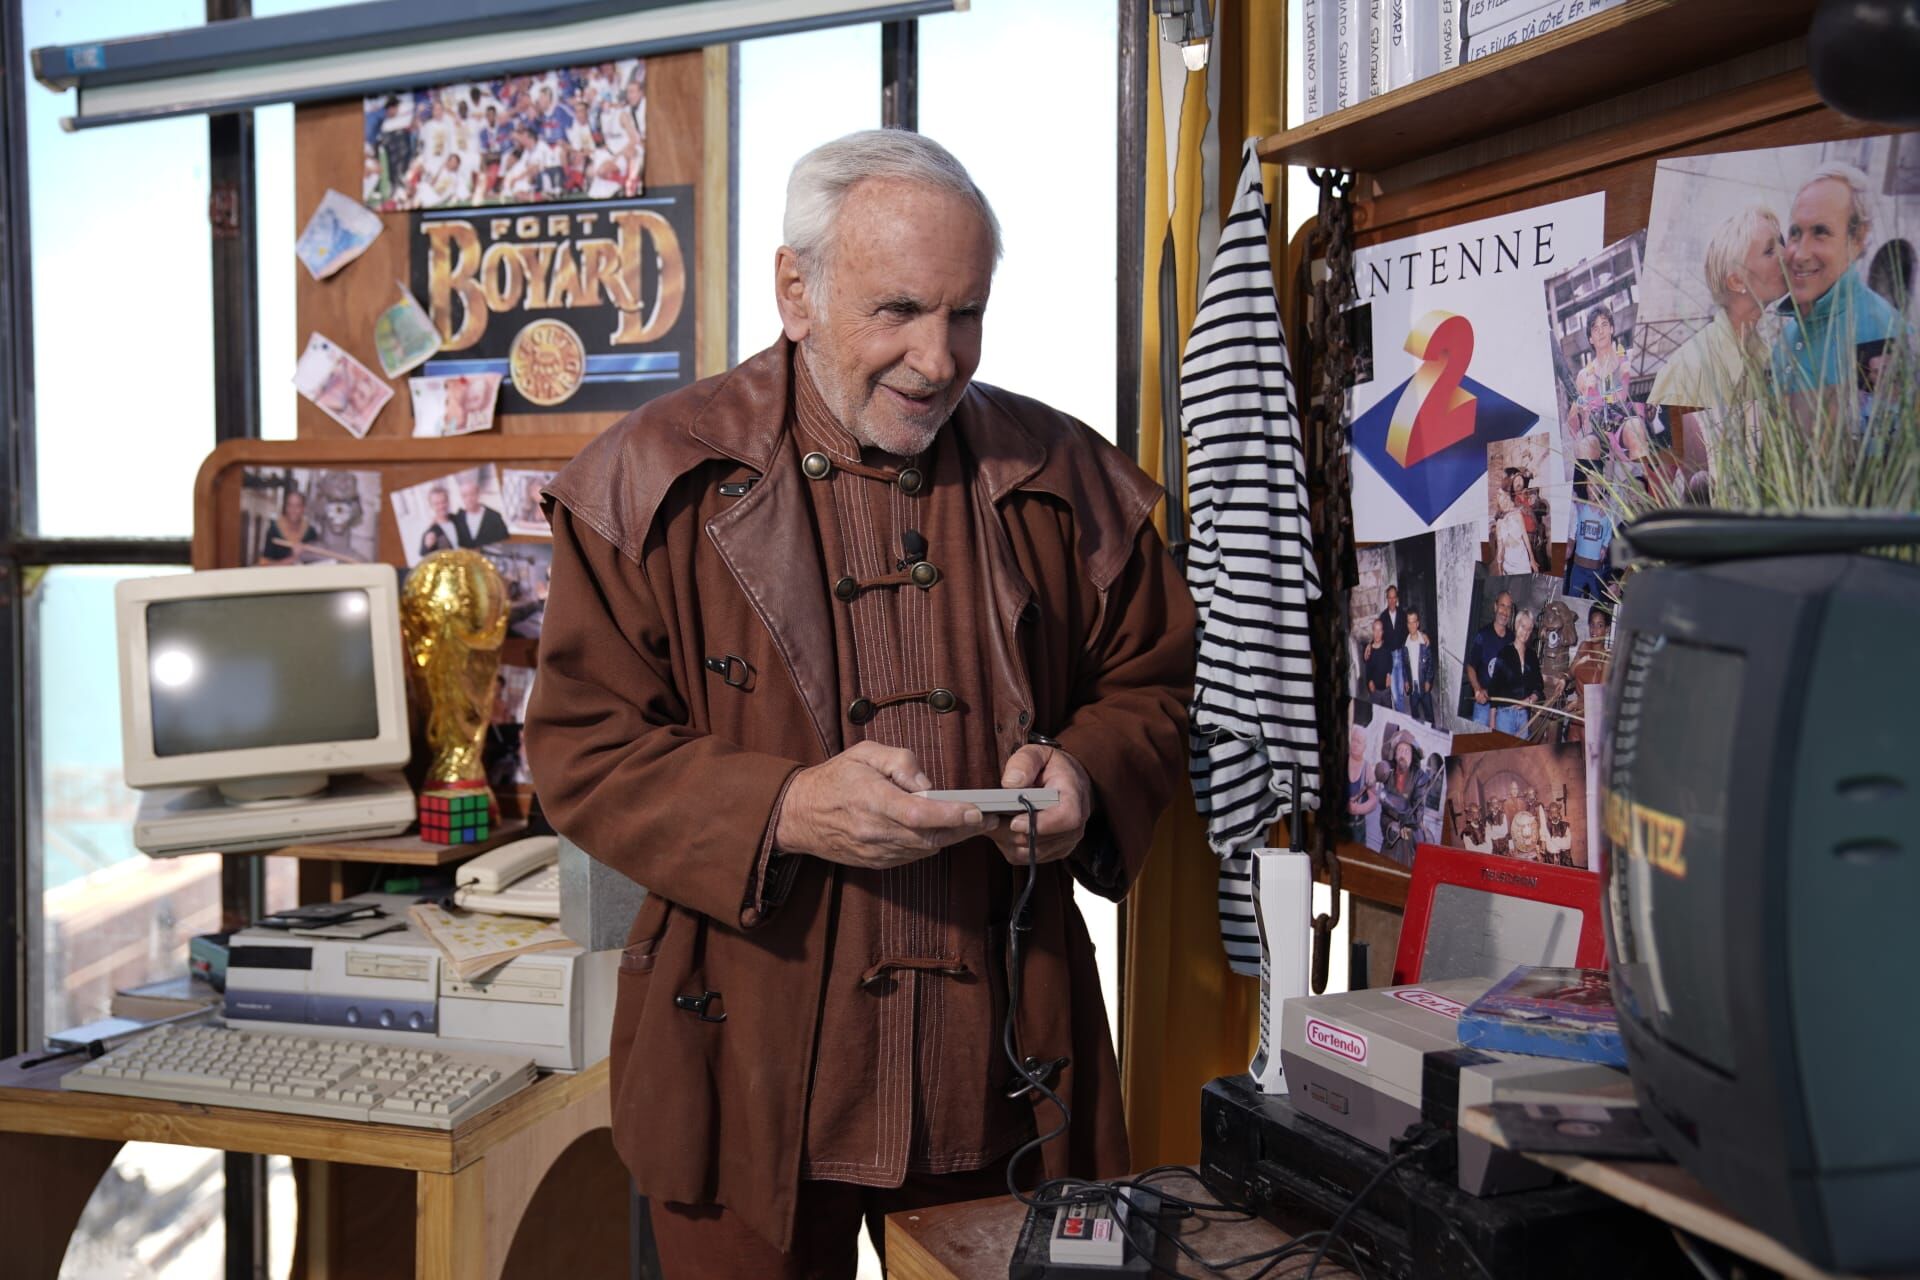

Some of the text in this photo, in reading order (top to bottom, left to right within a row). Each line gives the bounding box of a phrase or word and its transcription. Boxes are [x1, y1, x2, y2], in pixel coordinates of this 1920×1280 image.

[1470, 1, 1485, 18] LES
[1306, 11, 1317, 79] CANDIDAT
[1442, 19, 1453, 66] IMAGES
[1307, 84, 1318, 114] PIRE
[1338, 41, 1349, 110] ARCHIVES
[490, 213, 599, 240] FORT
[420, 209, 686, 353] BOYARD
[1385, 309, 1478, 469] 2
[1312, 1026, 1361, 1055] Fortendo
